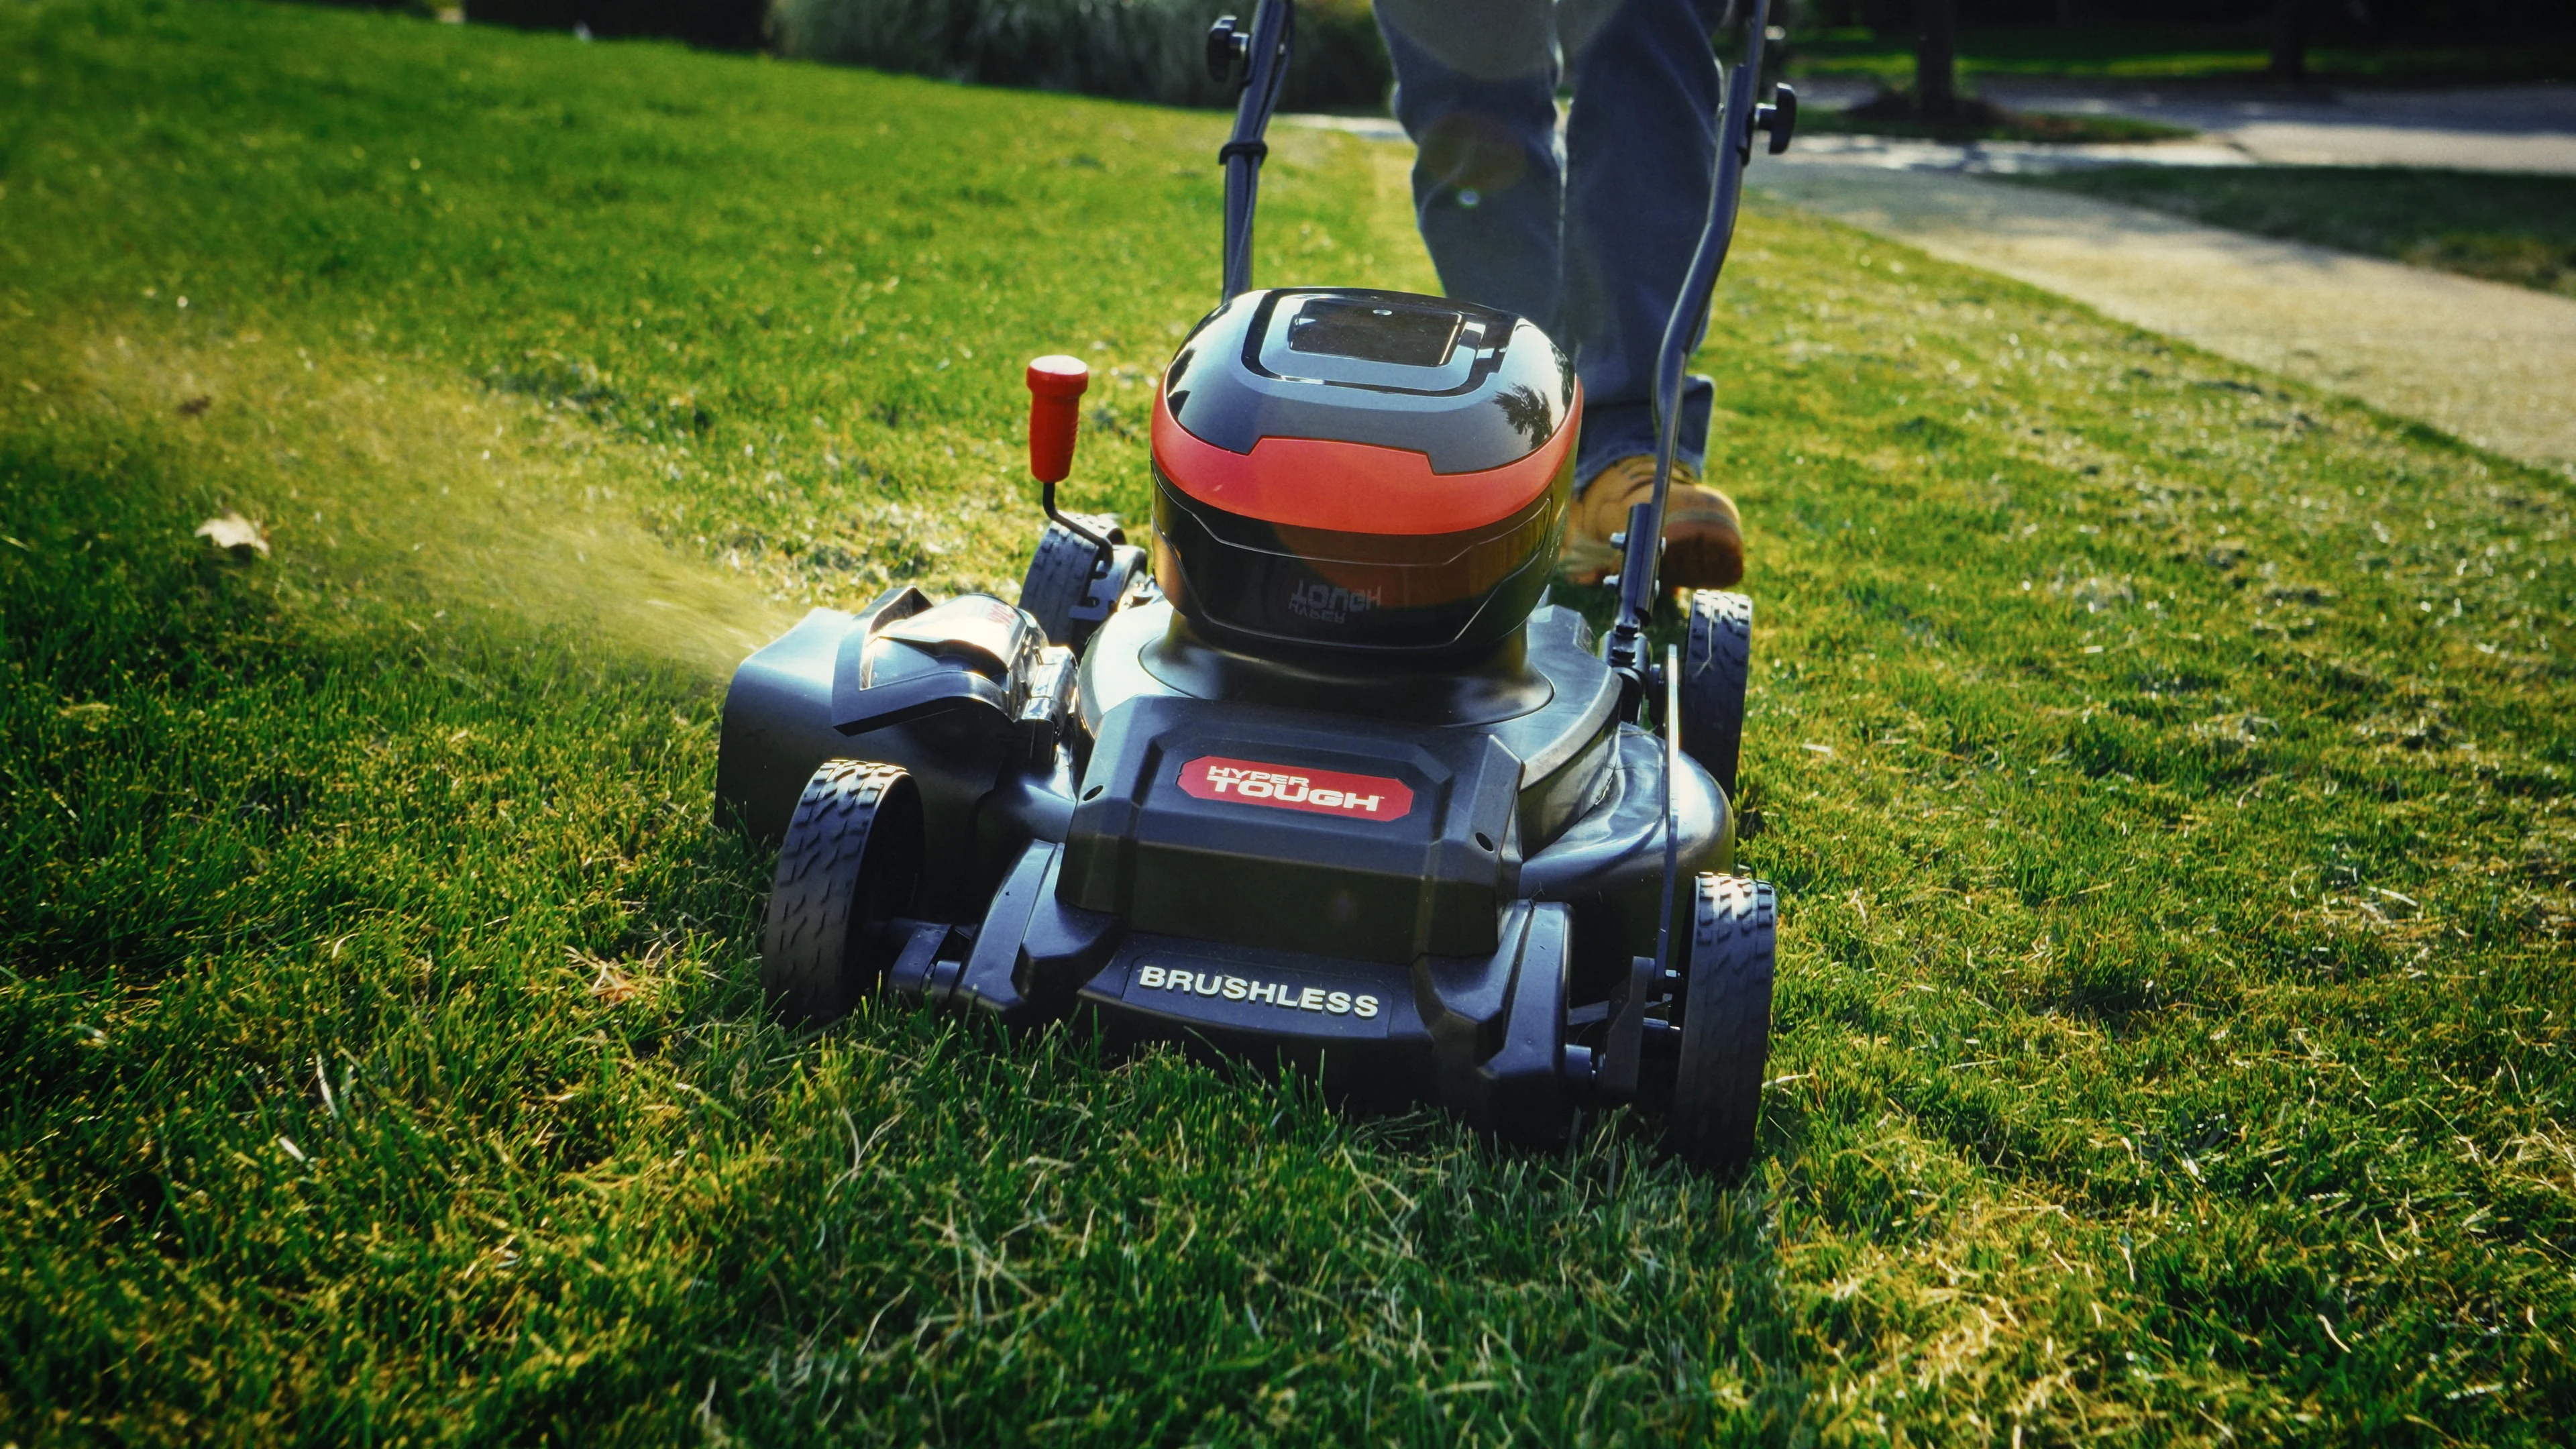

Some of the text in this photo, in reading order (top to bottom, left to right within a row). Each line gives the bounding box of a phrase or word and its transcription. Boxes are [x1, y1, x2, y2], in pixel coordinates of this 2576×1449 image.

[1207, 775, 1379, 812] TOUGH
[1208, 765, 1310, 788] HYPER
[1139, 965, 1379, 1018] BRUSHLESS
